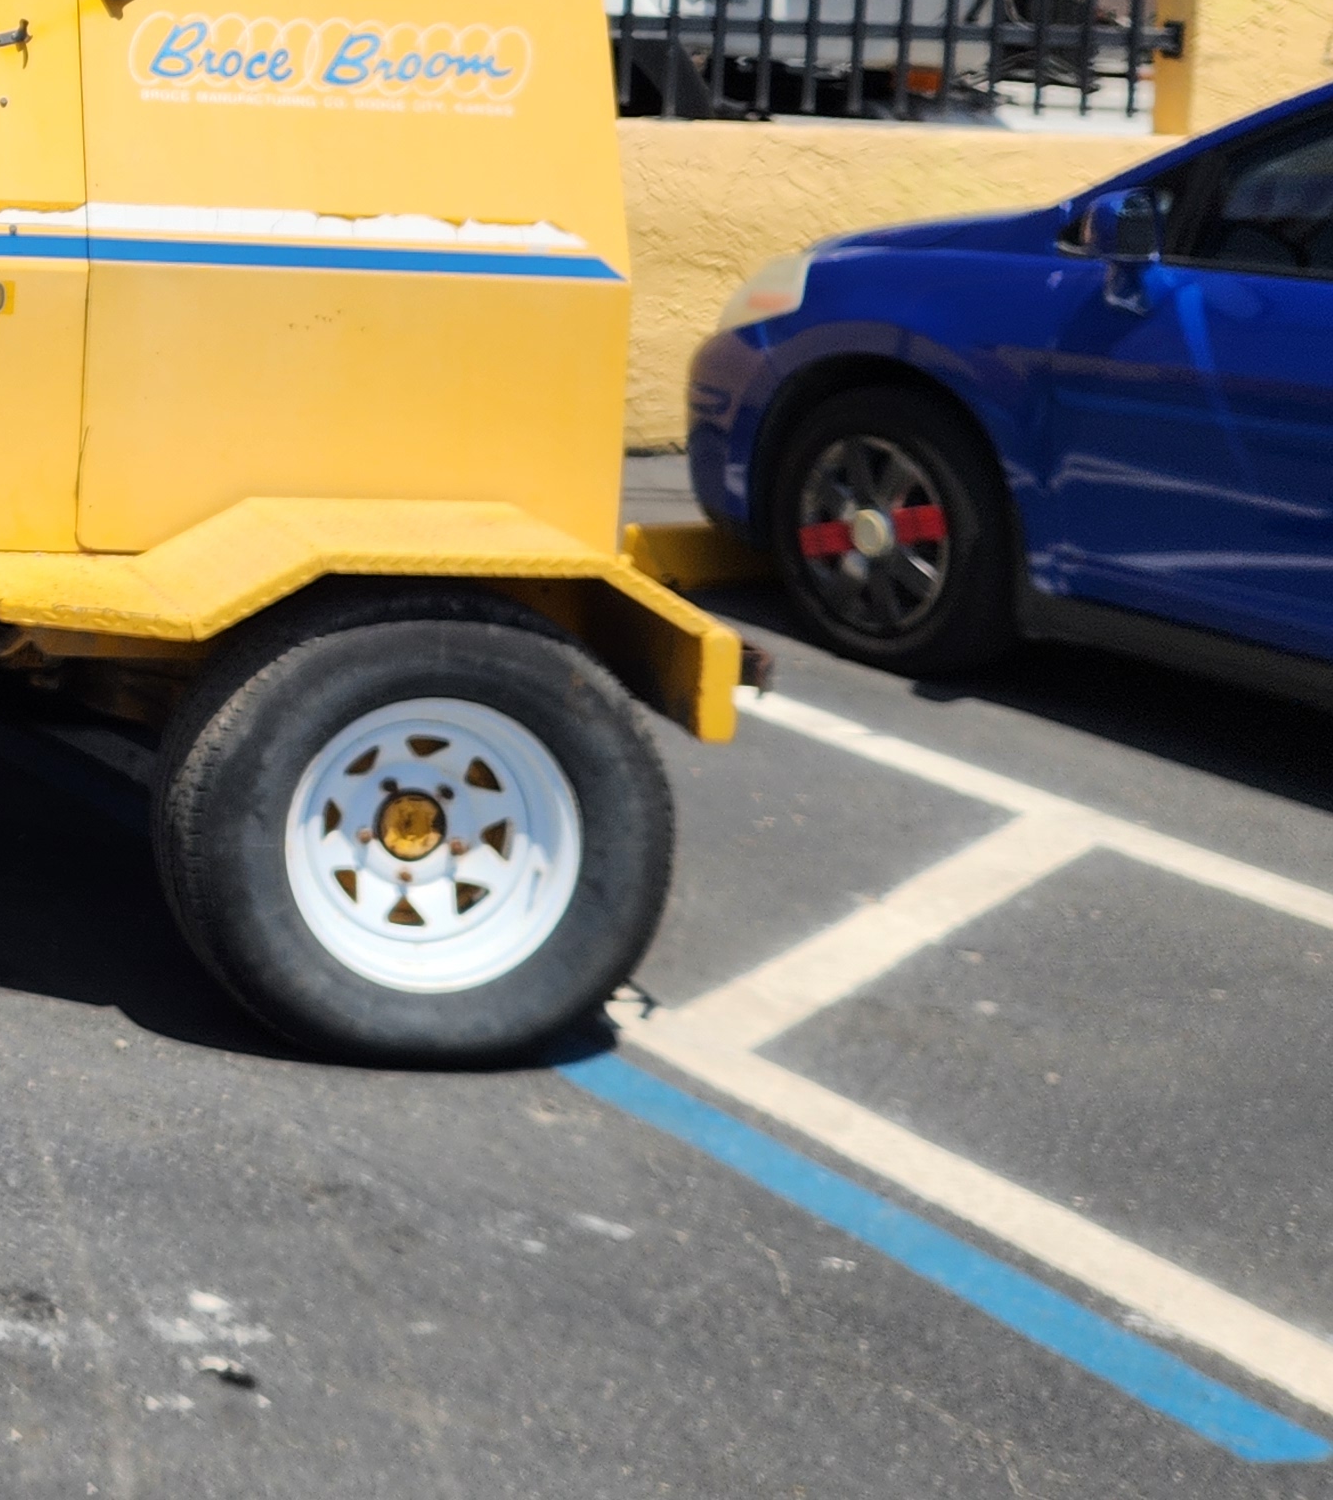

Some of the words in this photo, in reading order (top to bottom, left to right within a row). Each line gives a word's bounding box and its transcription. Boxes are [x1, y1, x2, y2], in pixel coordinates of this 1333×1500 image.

[149, 21, 293, 82] Broce
[322, 32, 513, 86] Broom
[140, 88, 190, 103] BROCE
